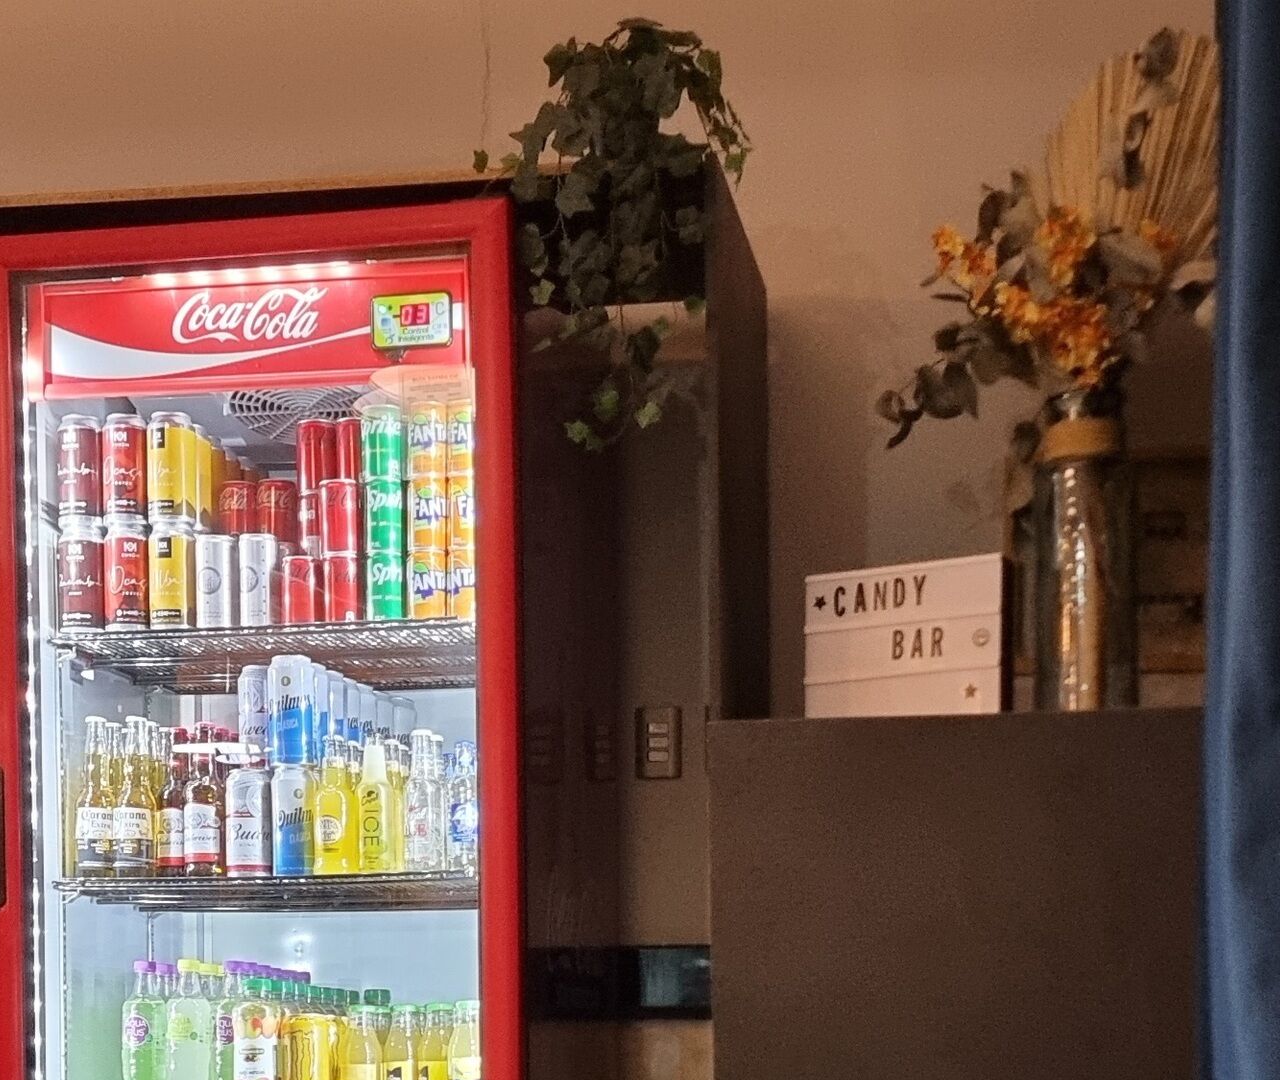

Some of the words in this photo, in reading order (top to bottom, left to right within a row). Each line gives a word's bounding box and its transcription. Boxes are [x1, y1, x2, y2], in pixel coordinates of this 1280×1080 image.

[171, 287, 327, 344] Coca-Cola
[413, 496, 446, 519] FANT
[833, 574, 927, 617] CANDY
[891, 626, 944, 660] BAR
[278, 806, 313, 831] Quilm
